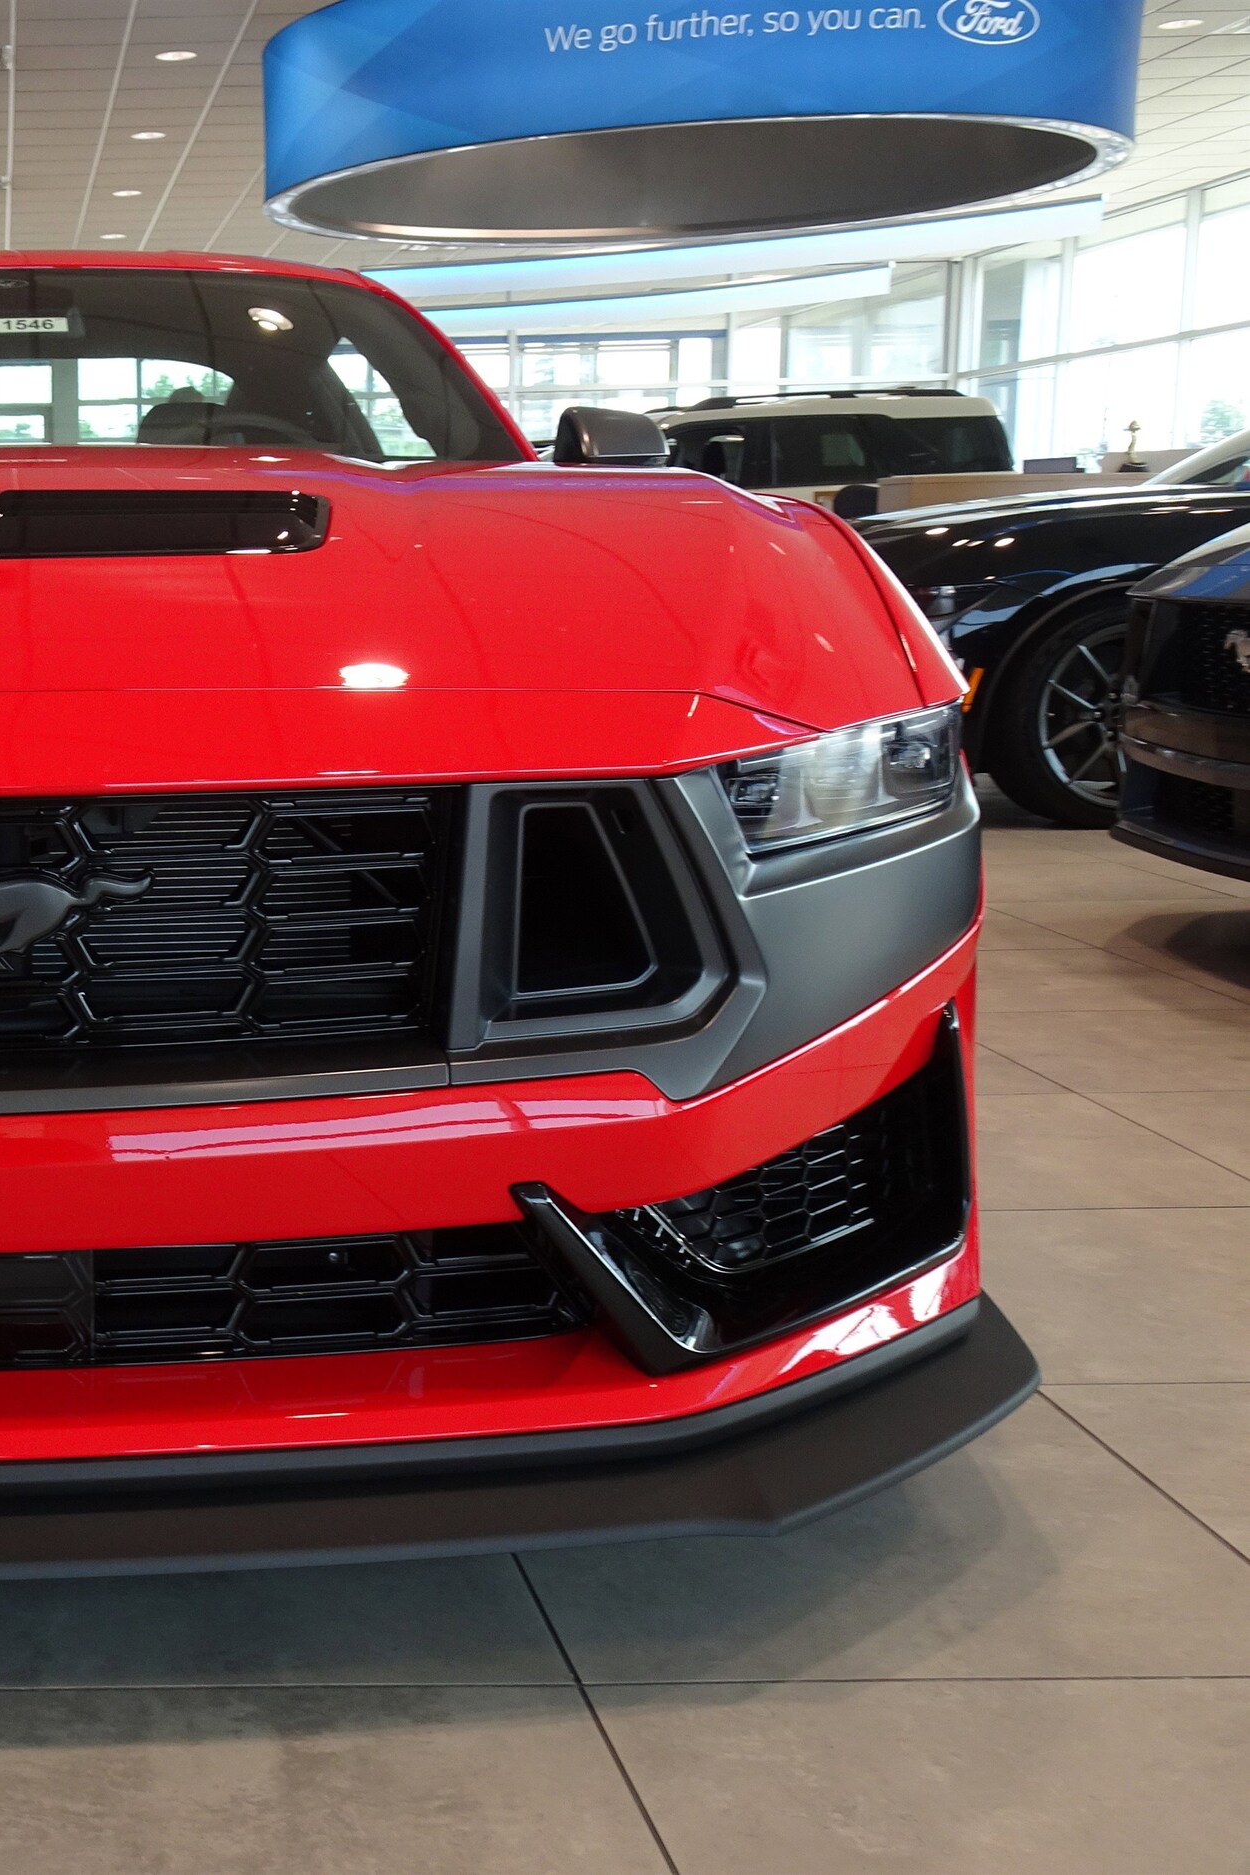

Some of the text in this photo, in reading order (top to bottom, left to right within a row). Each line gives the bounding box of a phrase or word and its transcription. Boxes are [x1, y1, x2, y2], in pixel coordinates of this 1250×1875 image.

[544, 7, 926, 52] We go further, so you can.
[956, 0, 1025, 36] Ford
